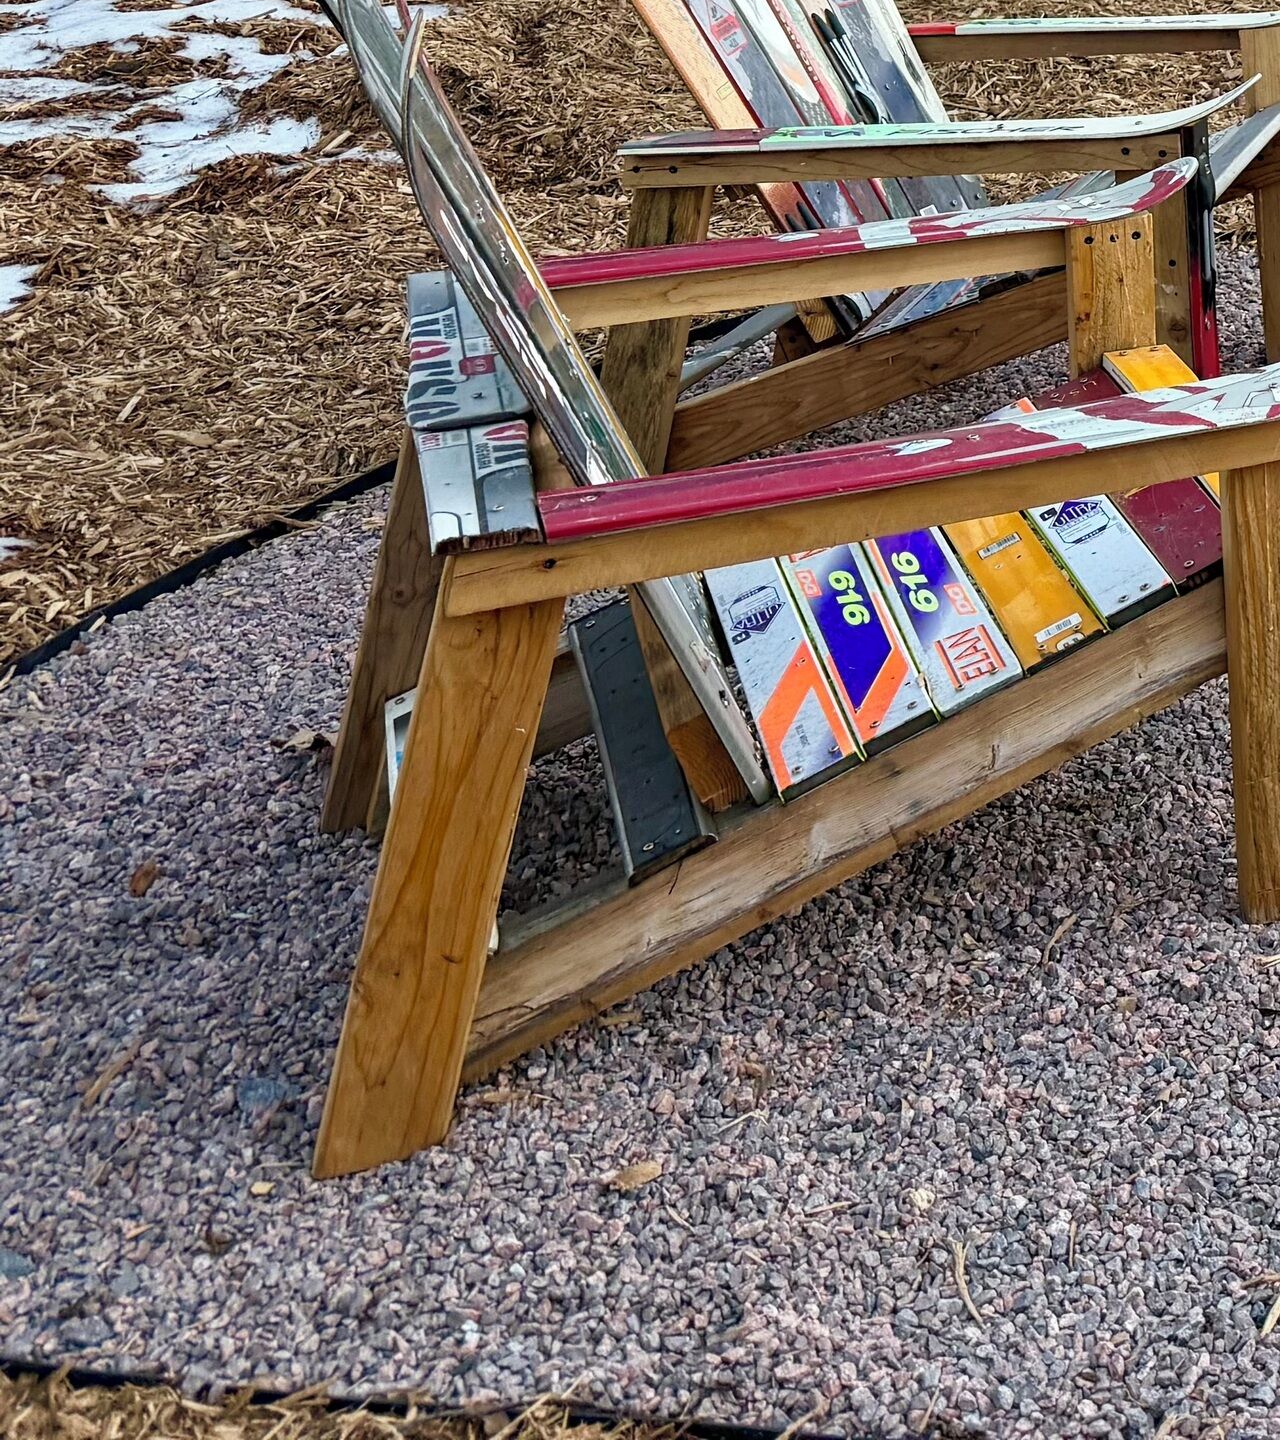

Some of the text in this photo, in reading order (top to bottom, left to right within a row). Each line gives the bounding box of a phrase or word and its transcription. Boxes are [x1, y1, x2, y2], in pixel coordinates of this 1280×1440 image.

[886, 124, 1085, 137] FISCHER
[1054, 502, 1099, 527] ULTRA
[828, 570, 871, 626] 616
[891, 551, 940, 614] 616
[736, 603, 782, 632] ULTRA
[943, 626, 997, 681] ELAN
